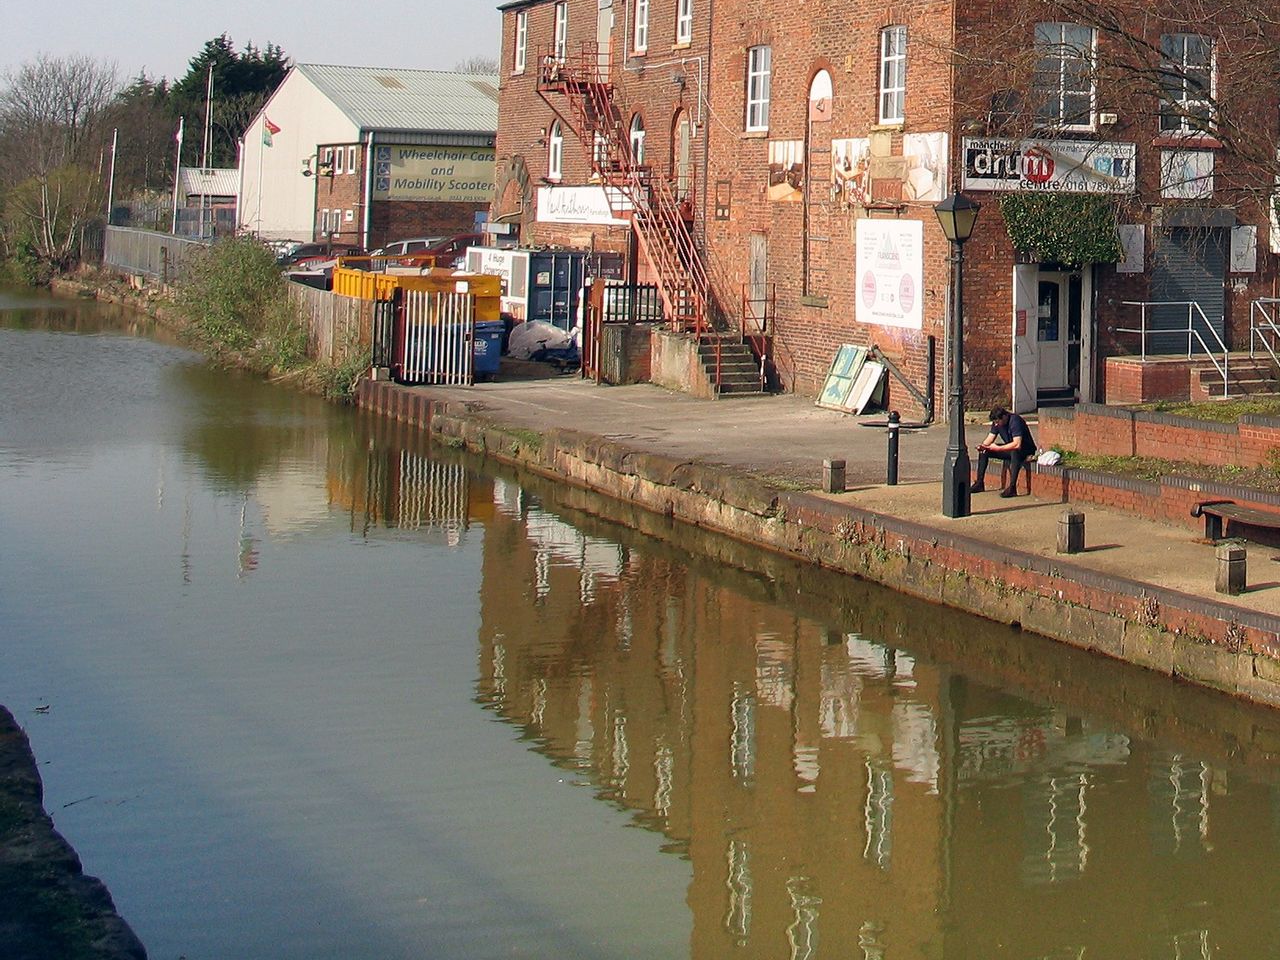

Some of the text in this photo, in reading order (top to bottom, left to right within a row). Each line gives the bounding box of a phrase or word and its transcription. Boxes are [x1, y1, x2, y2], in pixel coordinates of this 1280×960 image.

[400, 149, 468, 161] Wheelchair
[974, 146, 1049, 177] drum
[431, 165, 455, 176] and
[394, 178, 446, 192] Mobility
